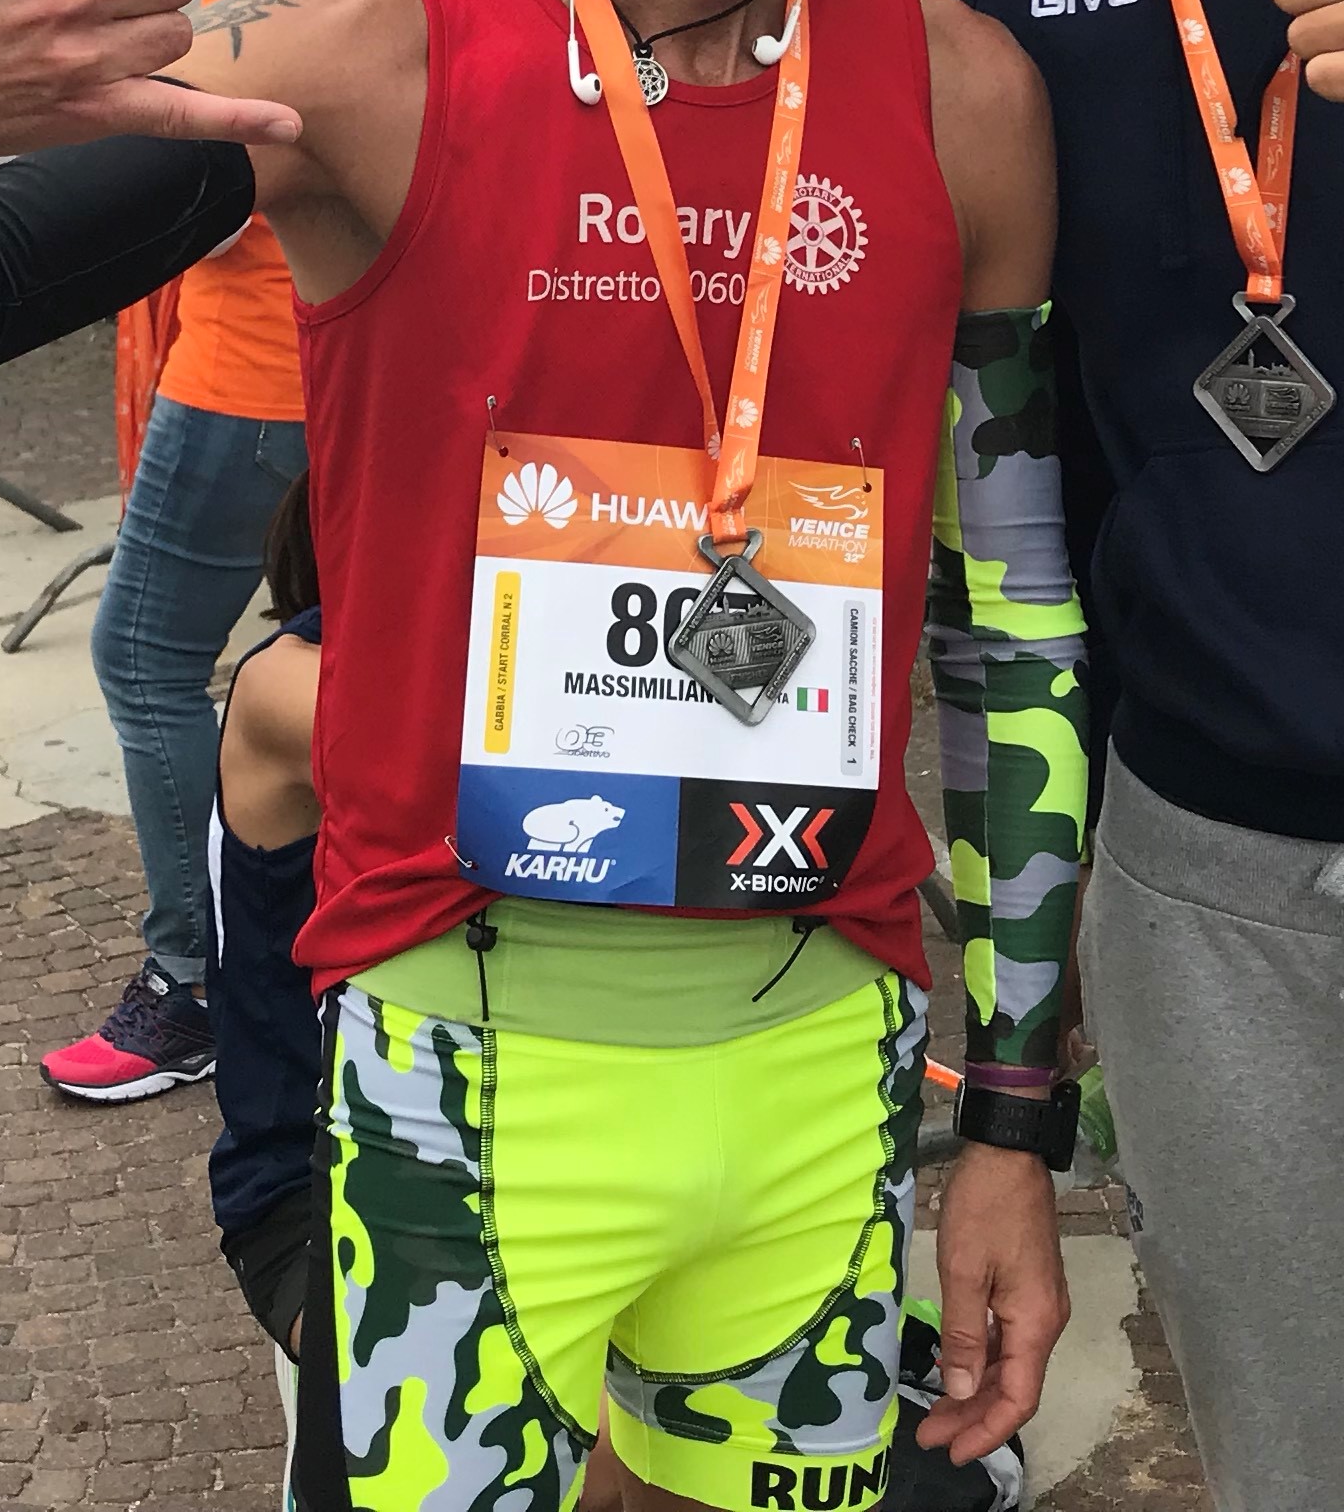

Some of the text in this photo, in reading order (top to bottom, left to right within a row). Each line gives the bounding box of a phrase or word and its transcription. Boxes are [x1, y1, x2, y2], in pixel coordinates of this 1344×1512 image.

[579, 193, 752, 259] Roary
[527, 267, 660, 303] Distretto
[785, 257, 850, 282] TERNATIONAL
[689, 270, 746, 305] 060
[591, 492, 746, 531] HUAW
[789, 517, 870, 540] VENICE
[788, 535, 867, 553] MARATHON
[500, 612, 512, 651] CORRAL
[850, 608, 859, 646] CAMION
[498, 654, 509, 685] START
[849, 648, 858, 685] SACCHE
[564, 671, 723, 704] MASSIMILIAN
[848, 694, 857, 713] BAG
[494, 694, 505, 731] GABBIA
[847, 716, 856, 747] CHECK
[504, 853, 611, 883] KARHU
[730, 874, 826, 894] X-BIONIC
[751, 1445, 891, 1511] RUN
